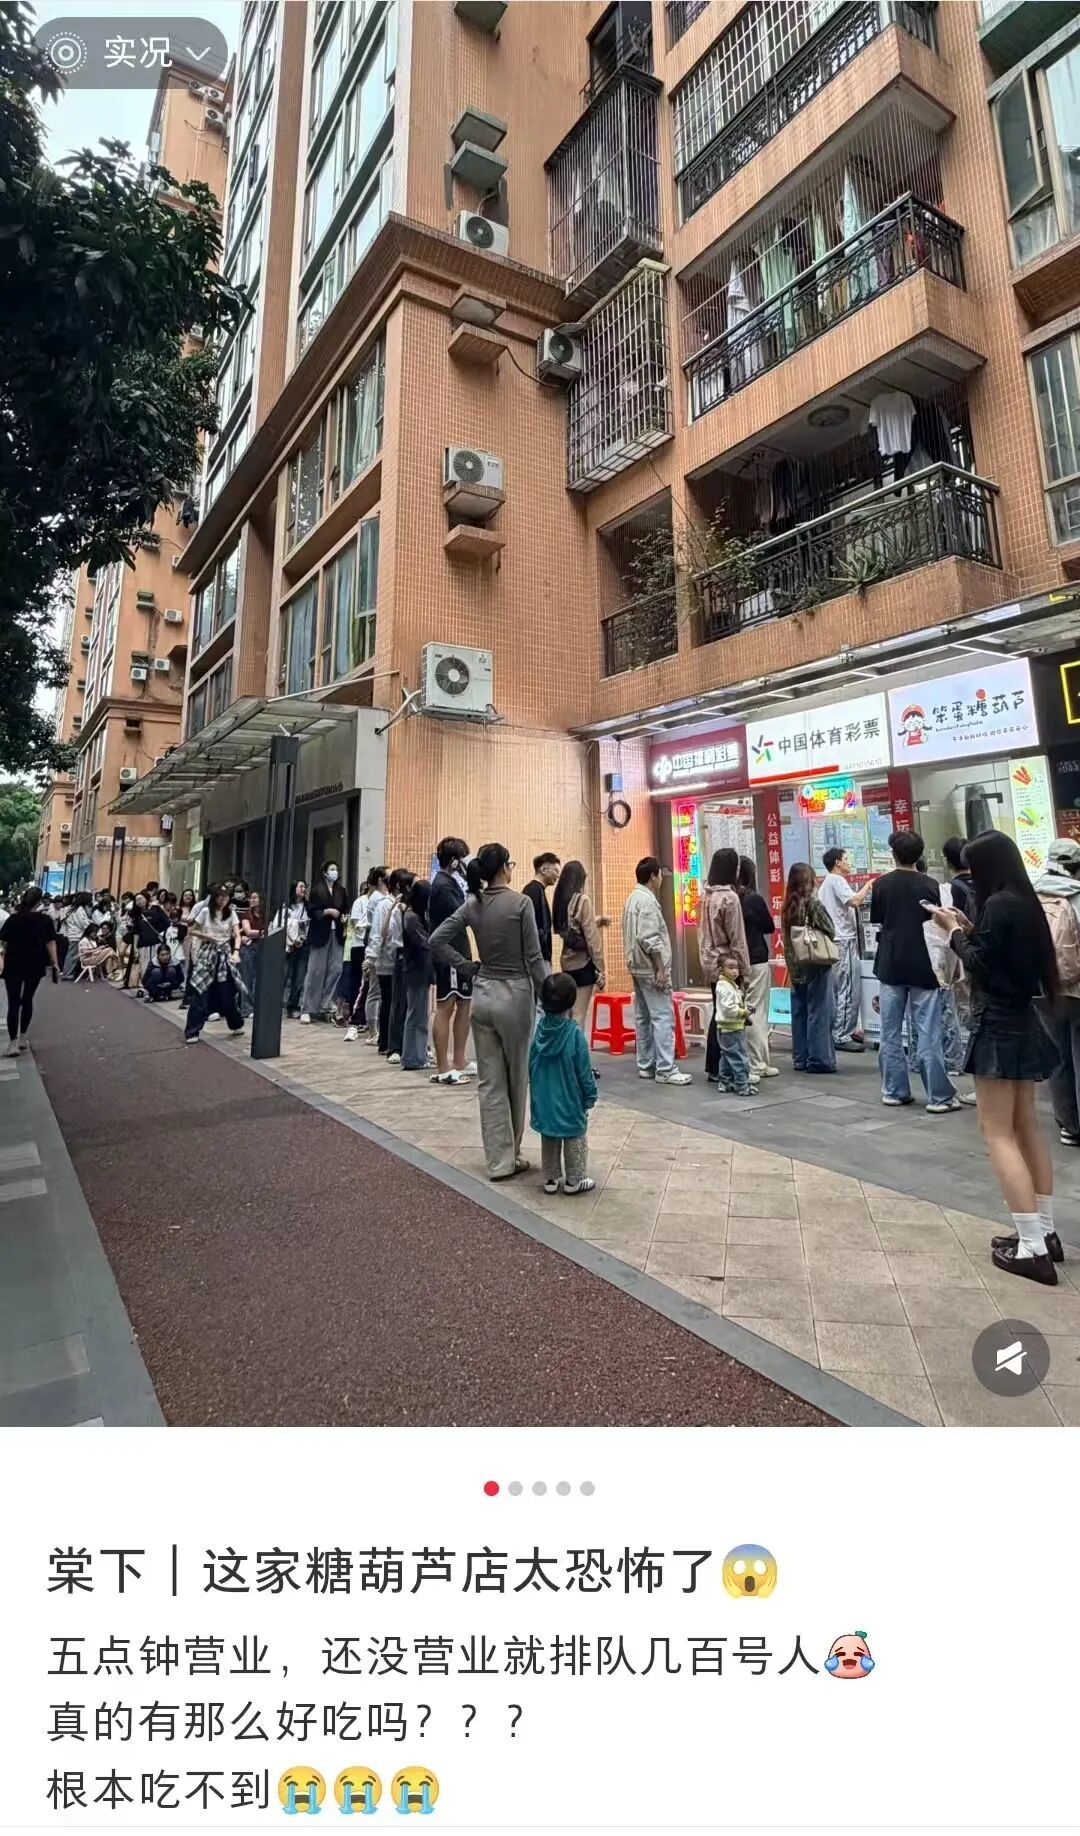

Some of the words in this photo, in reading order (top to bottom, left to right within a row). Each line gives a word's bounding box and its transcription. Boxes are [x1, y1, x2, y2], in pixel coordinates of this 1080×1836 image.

[932, 690, 1025, 724] 笨蛋糖葫芦
[778, 717, 880, 754] 中国体育彩票
